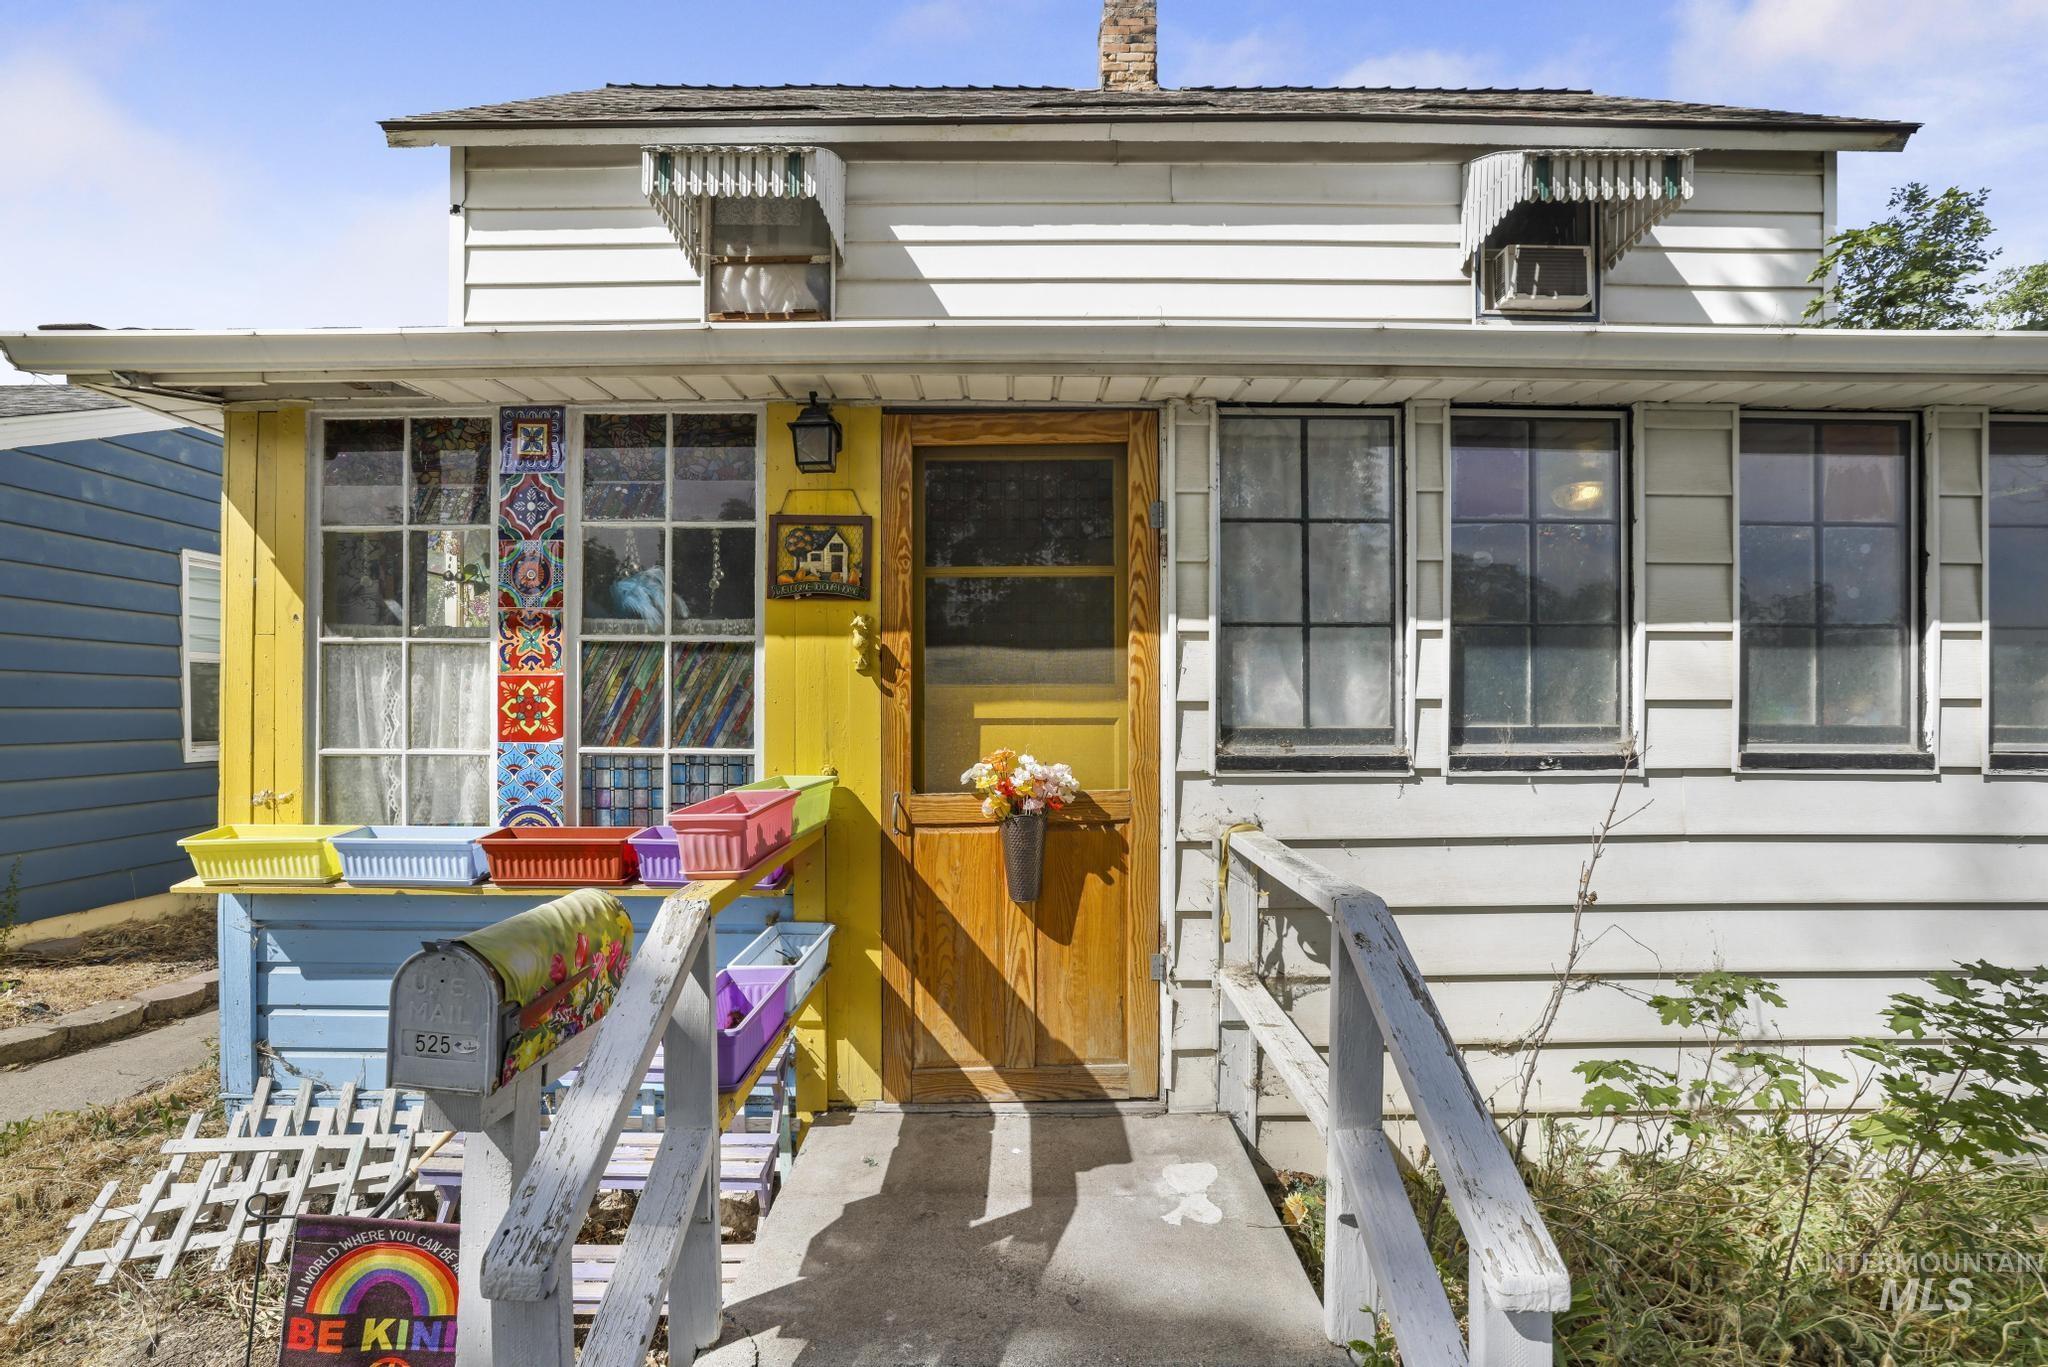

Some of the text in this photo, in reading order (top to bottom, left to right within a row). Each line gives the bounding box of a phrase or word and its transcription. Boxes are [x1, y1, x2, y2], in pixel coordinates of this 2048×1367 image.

[409, 1001, 473, 1025] MAIL
[415, 1034, 451, 1054] 525
[291, 1229, 458, 1308] IN A WORLD WHERE YOU CAN BE
[287, 1317, 346, 1355] BE
